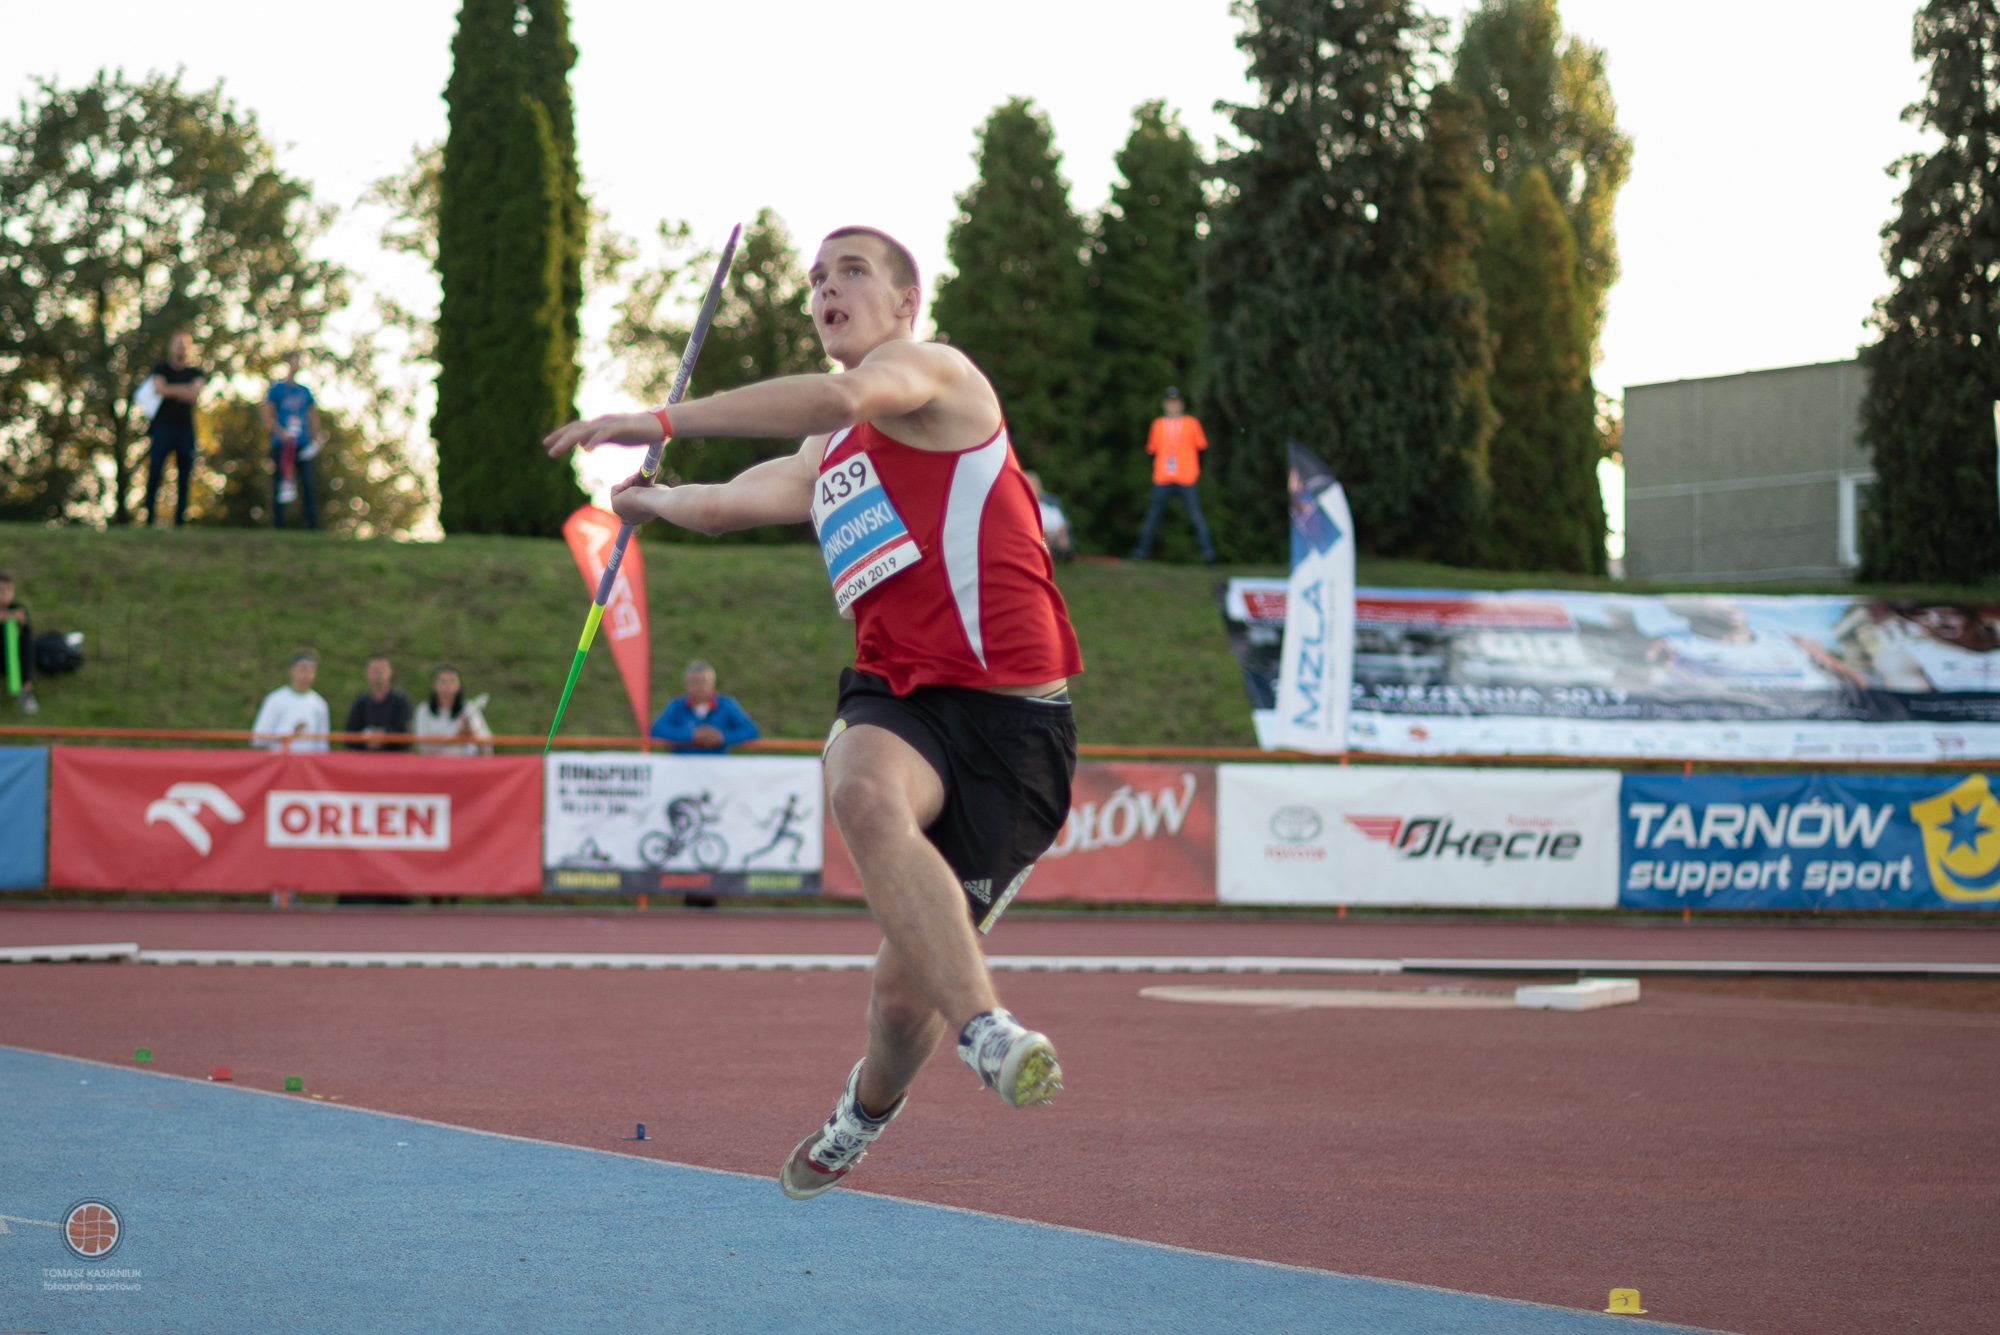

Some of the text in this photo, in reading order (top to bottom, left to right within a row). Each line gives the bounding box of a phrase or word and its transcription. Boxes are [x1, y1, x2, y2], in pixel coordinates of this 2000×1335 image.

[821, 460, 867, 506] 439
[868, 557, 897, 584] 2019
[1292, 578, 1325, 729] MZLA
[279, 802, 437, 837] ORLEN
[1628, 796, 1895, 849] TARNÓW
[963, 880, 992, 905] adidas
[1627, 854, 1913, 898] support sport
